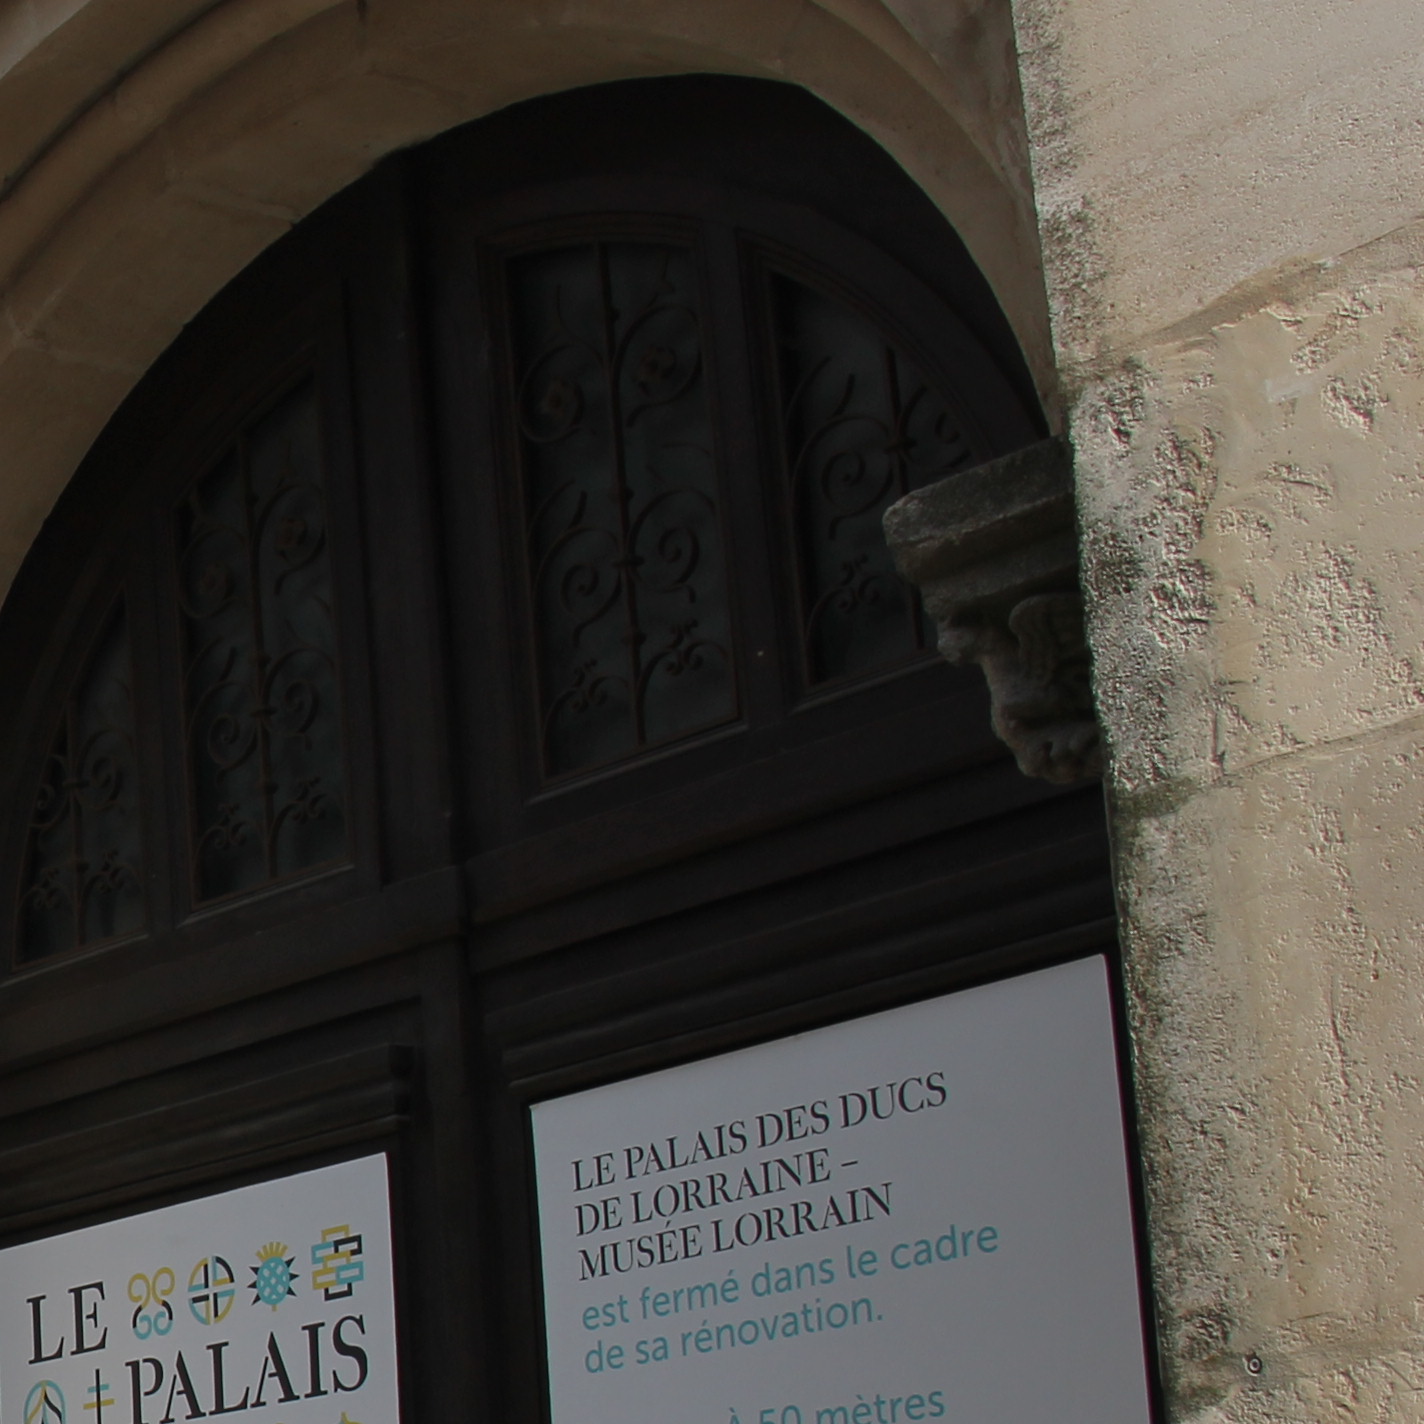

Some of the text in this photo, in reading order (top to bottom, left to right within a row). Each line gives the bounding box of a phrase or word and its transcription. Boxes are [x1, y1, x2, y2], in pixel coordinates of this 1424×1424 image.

[571, 1072, 948, 1191] LE PALAIS DES DUCS
[574, 1196, 623, 1236] DE
[632, 1148, 831, 1224] LORRAINE
[578, 1183, 892, 1282] MUSÉE LORRAIN
[582, 1220, 999, 1332] est fermé dans le cadre
[27, 1282, 107, 1364] LE
[585, 1294, 884, 1375] de sa rénovation.
